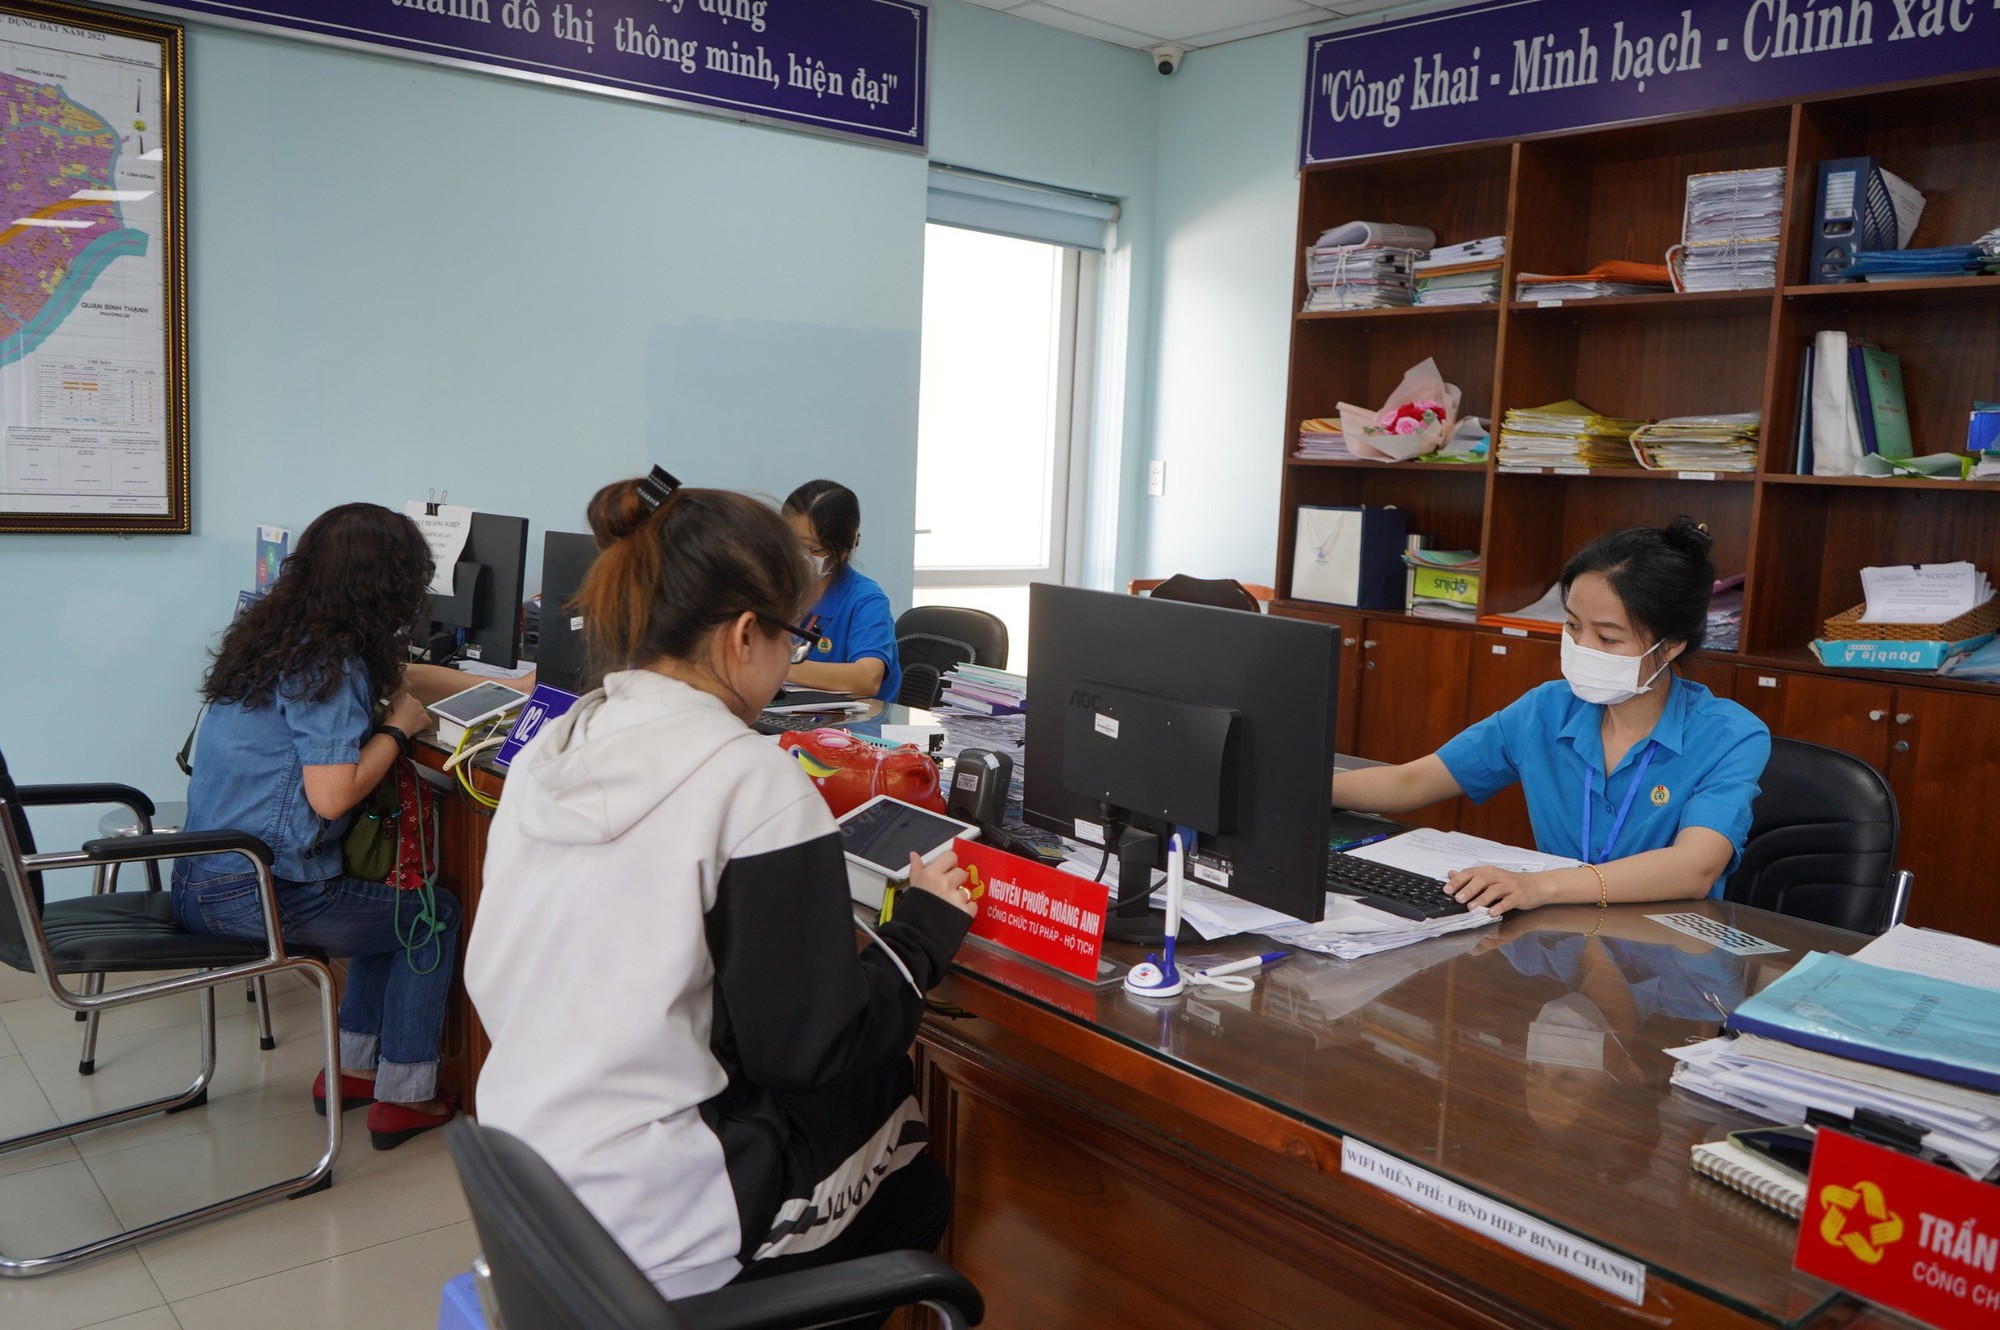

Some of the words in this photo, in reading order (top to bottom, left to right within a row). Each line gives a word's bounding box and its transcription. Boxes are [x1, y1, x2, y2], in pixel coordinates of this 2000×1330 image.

[87, 32, 107, 42] 2023
[552, 4, 595, 54] thị
[614, 17, 698, 73] thông
[705, 41, 780, 89] minh,
[788, 53, 844, 98] hiện
[851, 68, 898, 110] đại"
[1322, 69, 1405, 127] "Công
[1410, 46, 1480, 110] khai
[1508, 33, 1598, 95] Minh
[1611, 10, 1702, 93] bạch
[1743, 0, 1873, 62] Chính
[1844, 650, 1856, 662] A
[1861, 651, 1921, 663] Double
[514, 706, 544, 742] 02
[988, 877, 1022, 908] NGUYỄN
[1020, 889, 1050, 918] PHƯỚC
[1080, 910, 1101, 936] ANH
[987, 905, 1007, 923] CÔNG
[1007, 913, 1028, 931] CHỨC
[1028, 921, 1039, 935] TƯ
[1038, 926, 1060, 942] PHÁP
[1063, 934, 1076, 951] HỘ
[1076, 938, 1094, 956] TỊCH
[1347, 1149, 1376, 1172] WIFI
[1447, 1194, 1488, 1222] UBND
[1912, 1261, 1968, 1299] CÔNG
